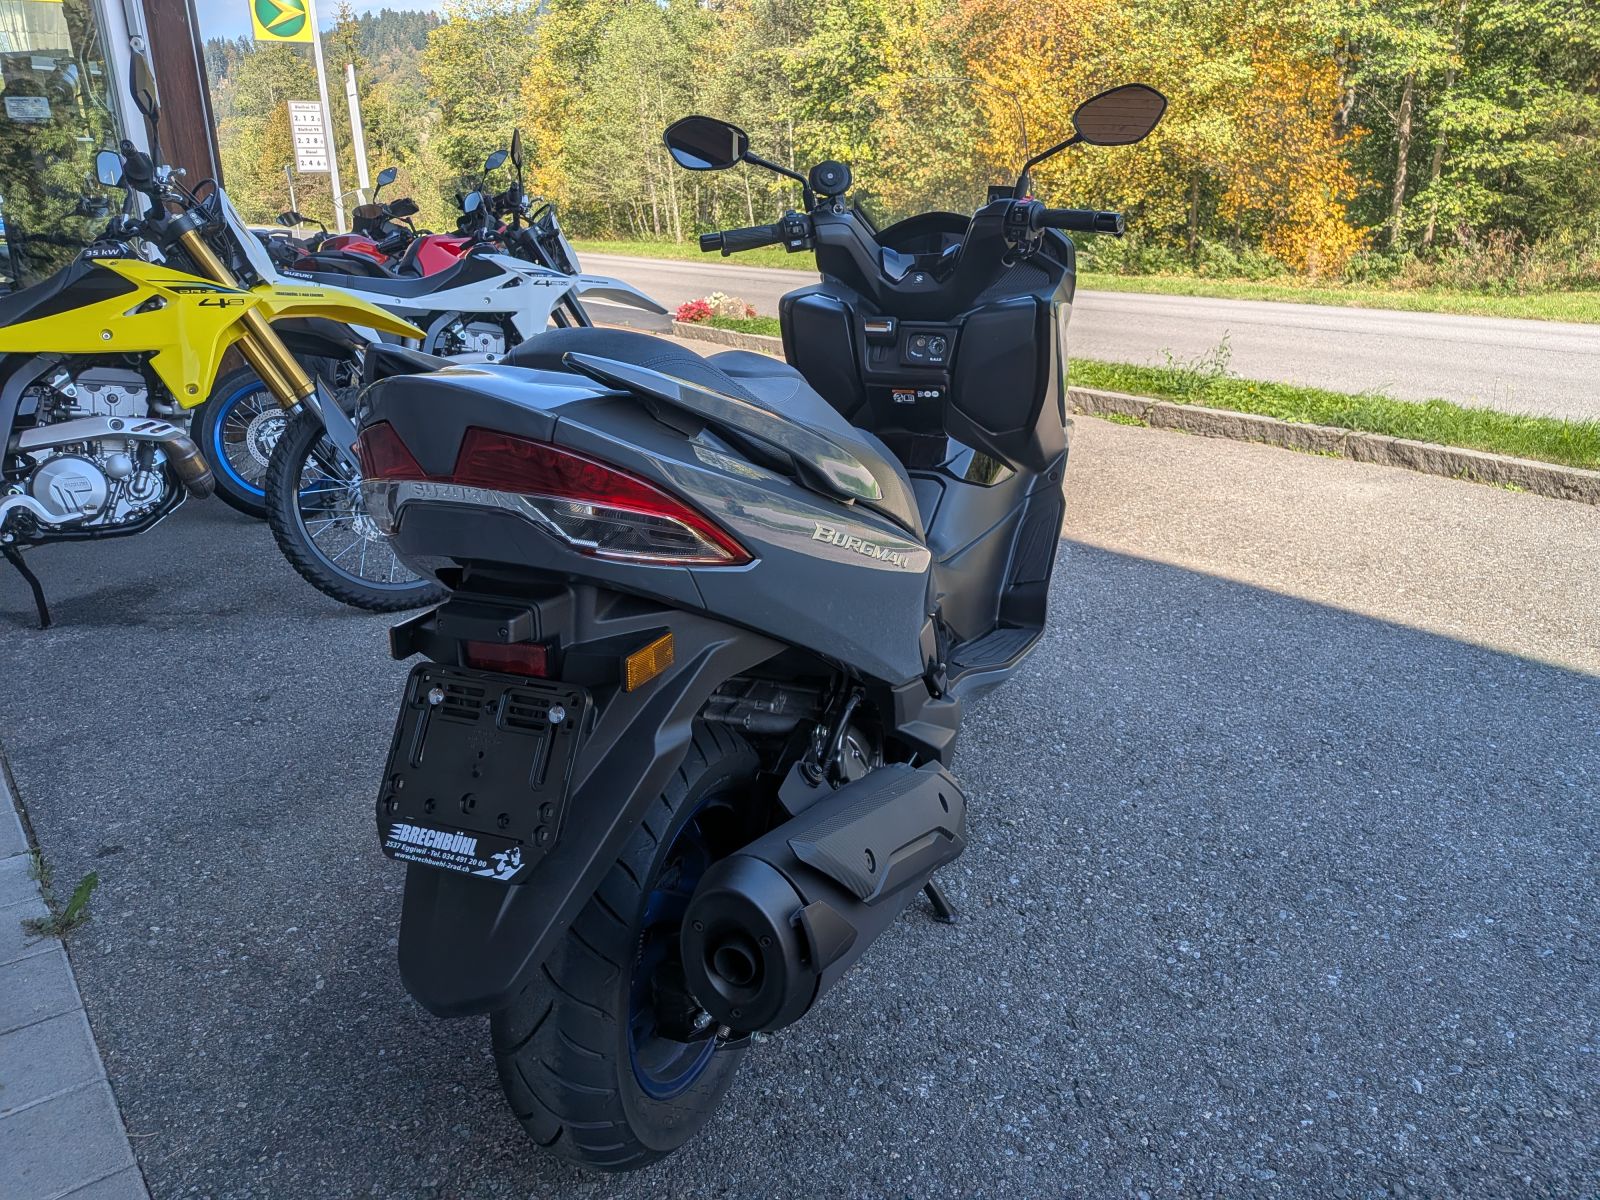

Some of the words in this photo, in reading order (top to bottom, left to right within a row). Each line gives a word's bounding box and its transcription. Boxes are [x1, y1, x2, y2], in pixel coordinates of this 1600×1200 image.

[283, 271, 313, 279] SUZUKI
[812, 520, 909, 568] BURGMAN
[399, 823, 478, 856] BRECHBÜHL
[385, 840, 401, 849] 3537
[401, 844, 426, 855] Eggiwil
[430, 850, 441, 858] Tel.
[442, 852, 455, 860] 034
[455, 855, 468, 863] 491
[468, 857, 477, 865] 20
[477, 860, 487, 868] 00
[394, 851, 470, 872] www.brechbuehl-2rad.ch
